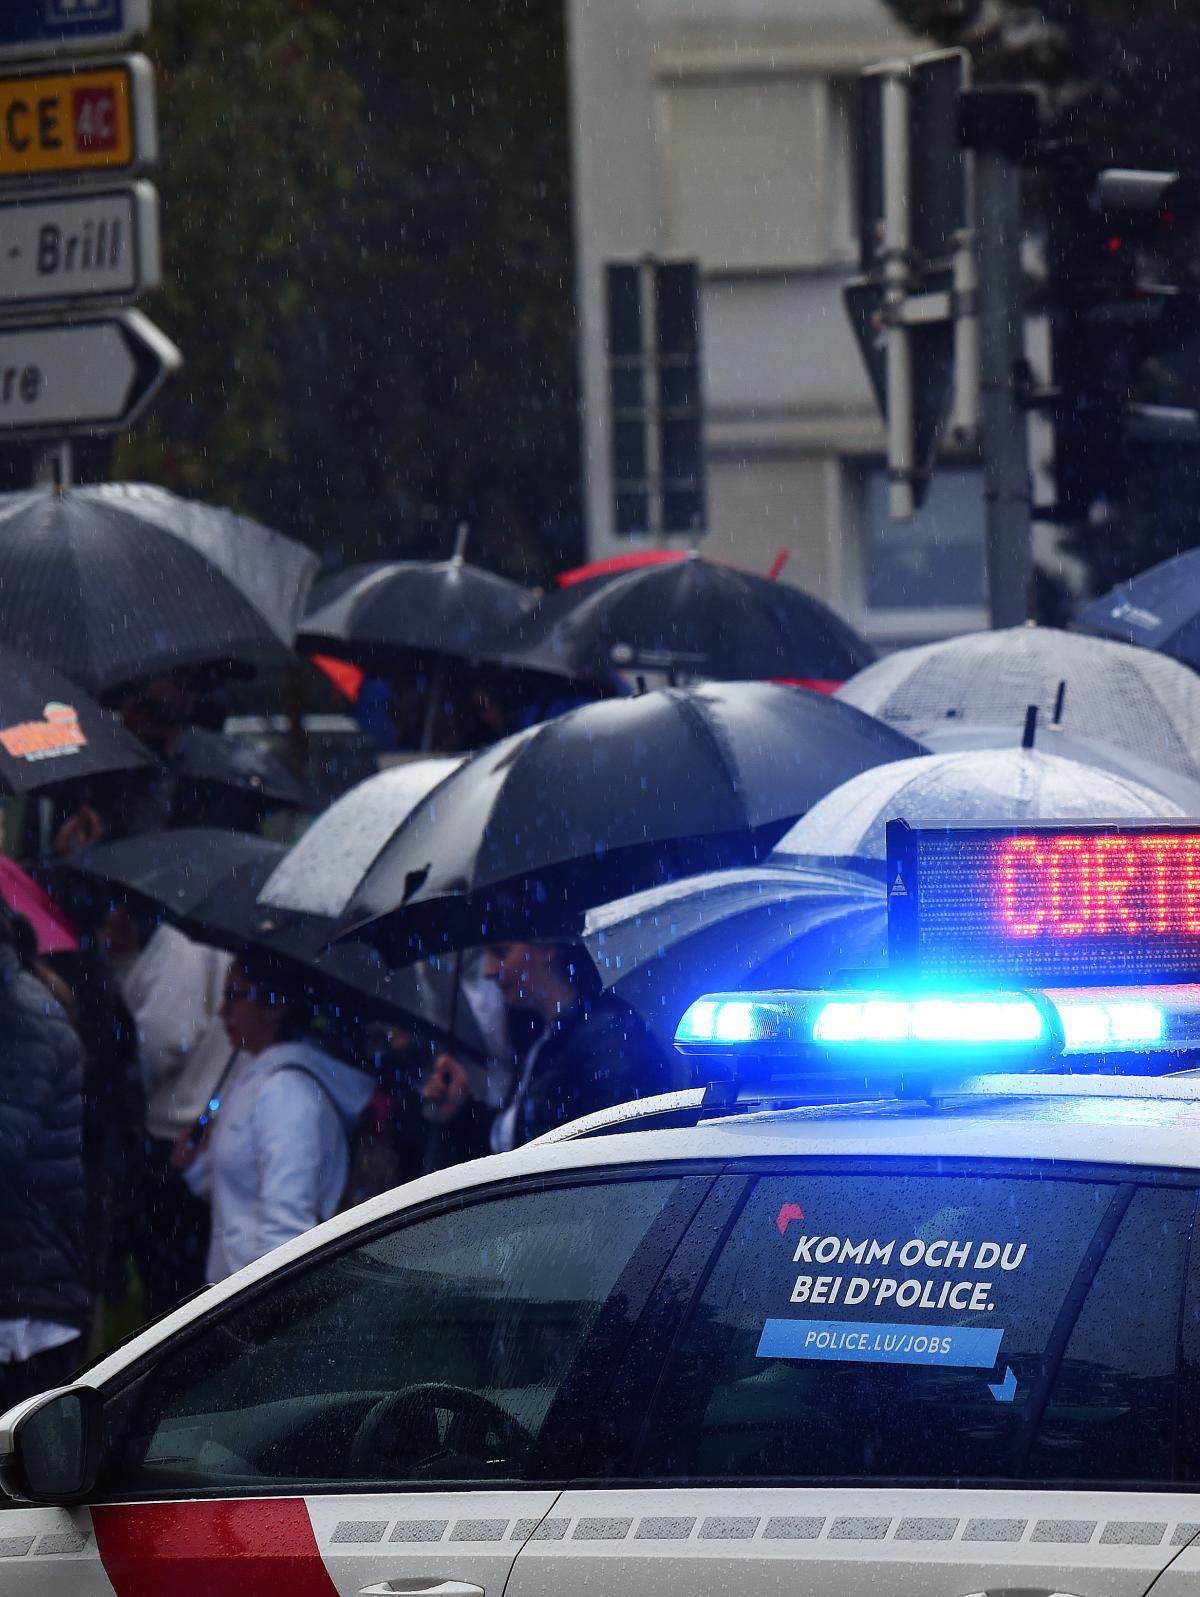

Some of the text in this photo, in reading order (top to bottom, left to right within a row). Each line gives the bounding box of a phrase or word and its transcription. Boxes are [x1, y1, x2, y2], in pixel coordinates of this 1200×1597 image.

[37, 218, 121, 276] Brill
[792, 1236, 1027, 1270] KOMM OCH DU
[789, 1275, 842, 1304] BEI
[804, 1331, 952, 1354] POLICE.LU/JOBS
